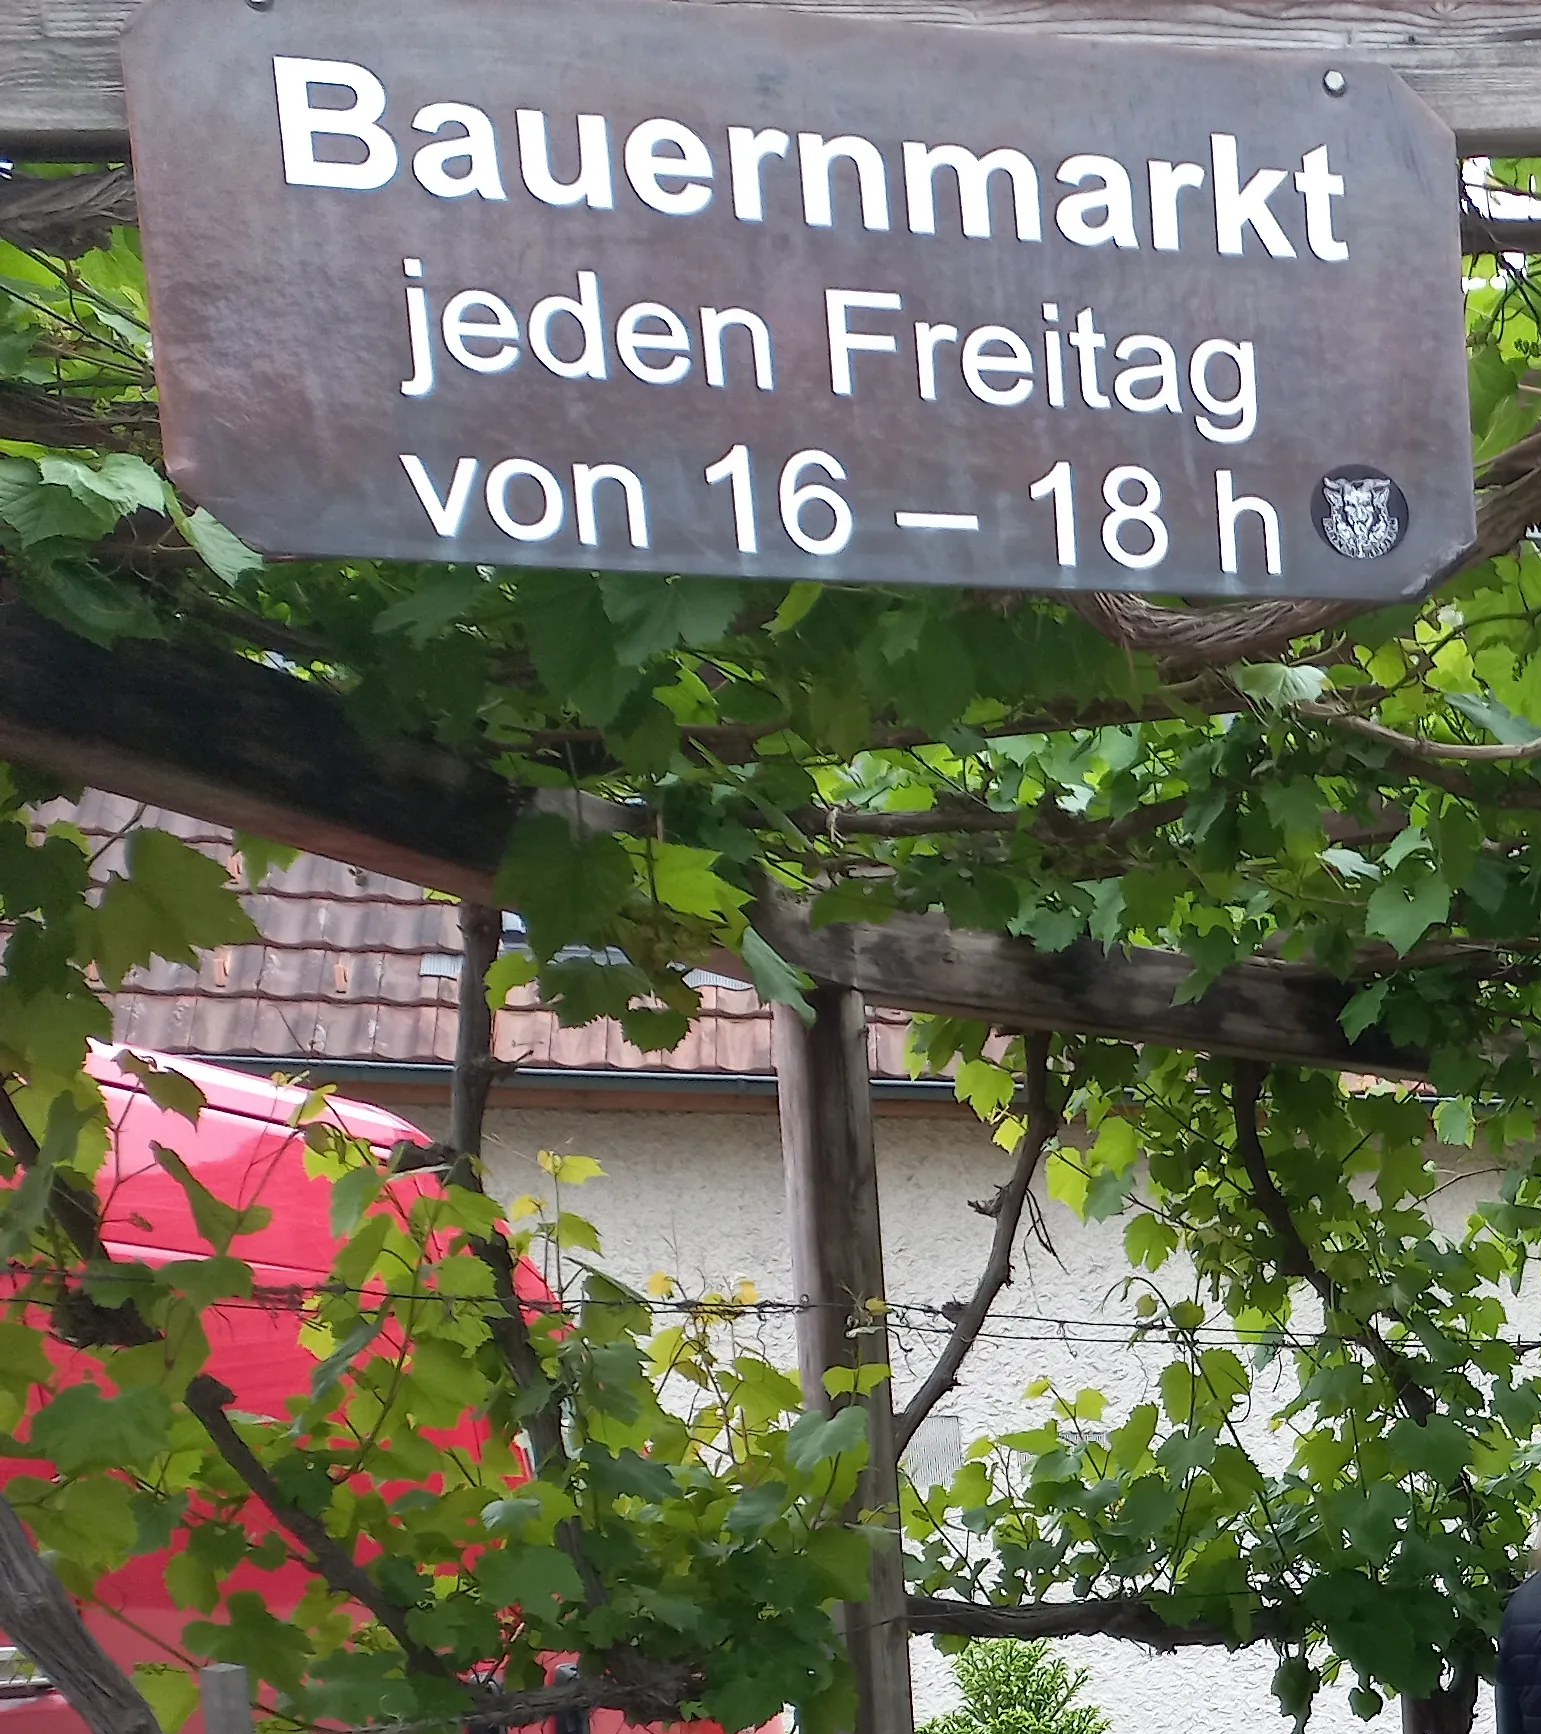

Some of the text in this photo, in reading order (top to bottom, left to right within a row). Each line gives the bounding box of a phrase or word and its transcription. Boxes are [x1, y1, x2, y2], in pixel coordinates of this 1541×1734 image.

[273, 54, 1350, 263] Bauernmarkt
[401, 259, 1258, 443] jeden Freitag
[400, 453, 650, 549] von
[706, 443, 853, 557] 16
[1029, 460, 1170, 570] 18
[1216, 468, 1282, 576] h
